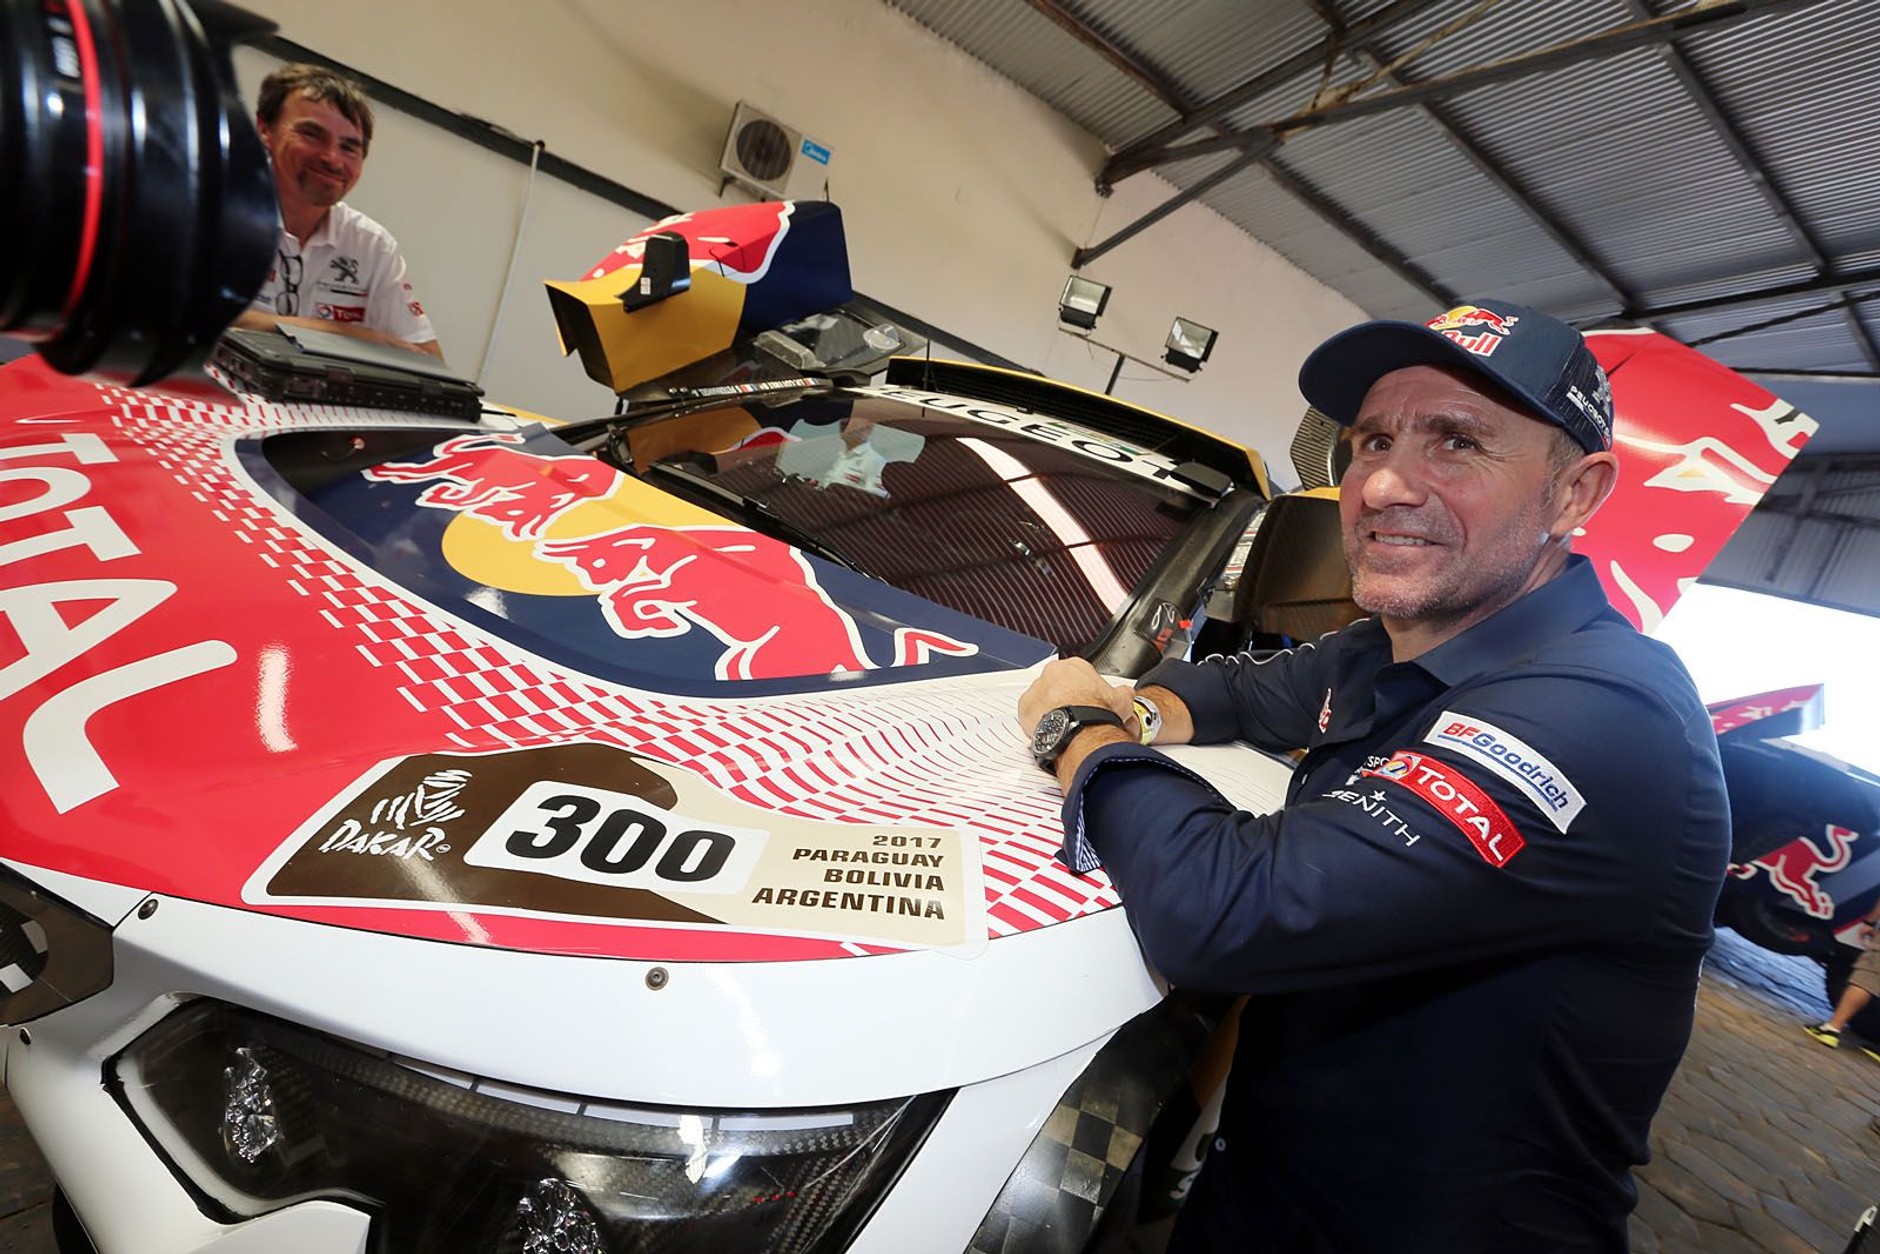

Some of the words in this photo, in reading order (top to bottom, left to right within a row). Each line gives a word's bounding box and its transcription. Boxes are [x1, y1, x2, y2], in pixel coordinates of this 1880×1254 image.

[879, 387, 1172, 481] EUGEOT
[1443, 722, 1569, 810] BFGoodrich
[1417, 765, 1504, 862] TOTAL
[318, 819, 446, 861] DAKAR
[504, 794, 737, 883] 300
[792, 848, 945, 868] PARAGUAY
[872, 835, 942, 849] 2017
[823, 868, 945, 891] BOLIVIA
[751, 887, 946, 920] ARGENTINA
